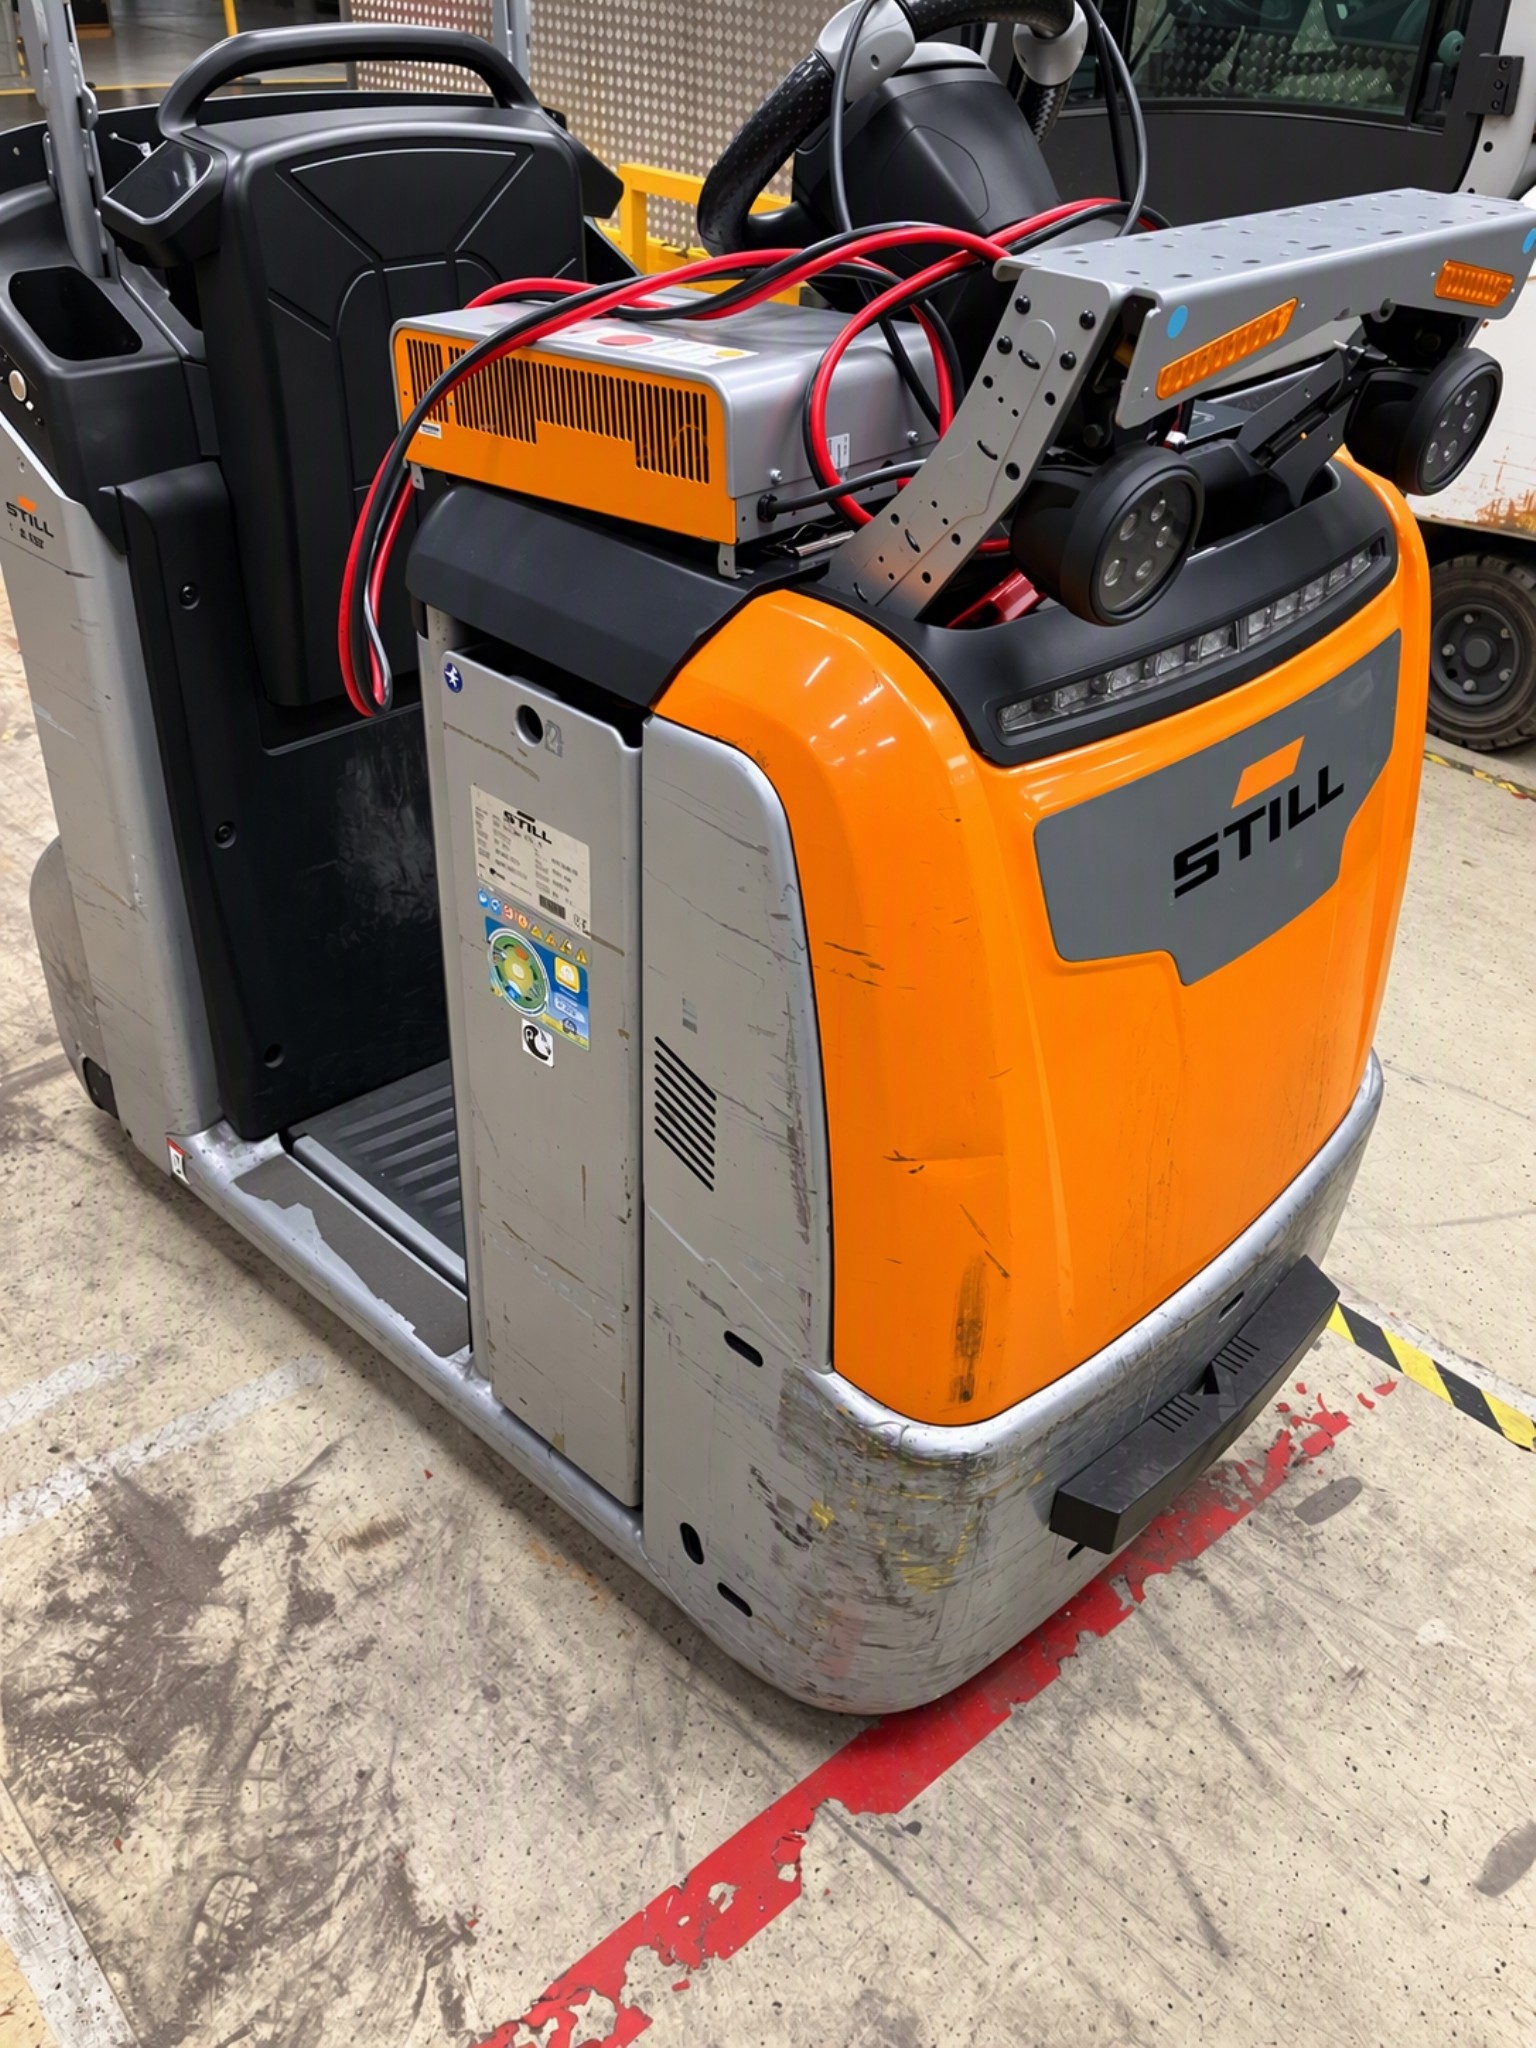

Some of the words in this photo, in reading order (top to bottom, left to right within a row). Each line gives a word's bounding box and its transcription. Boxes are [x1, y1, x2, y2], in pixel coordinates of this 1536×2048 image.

[6, 501, 54, 538] STILL
[503, 810, 552, 845] STILL
[1173, 765, 1344, 899] STILL
